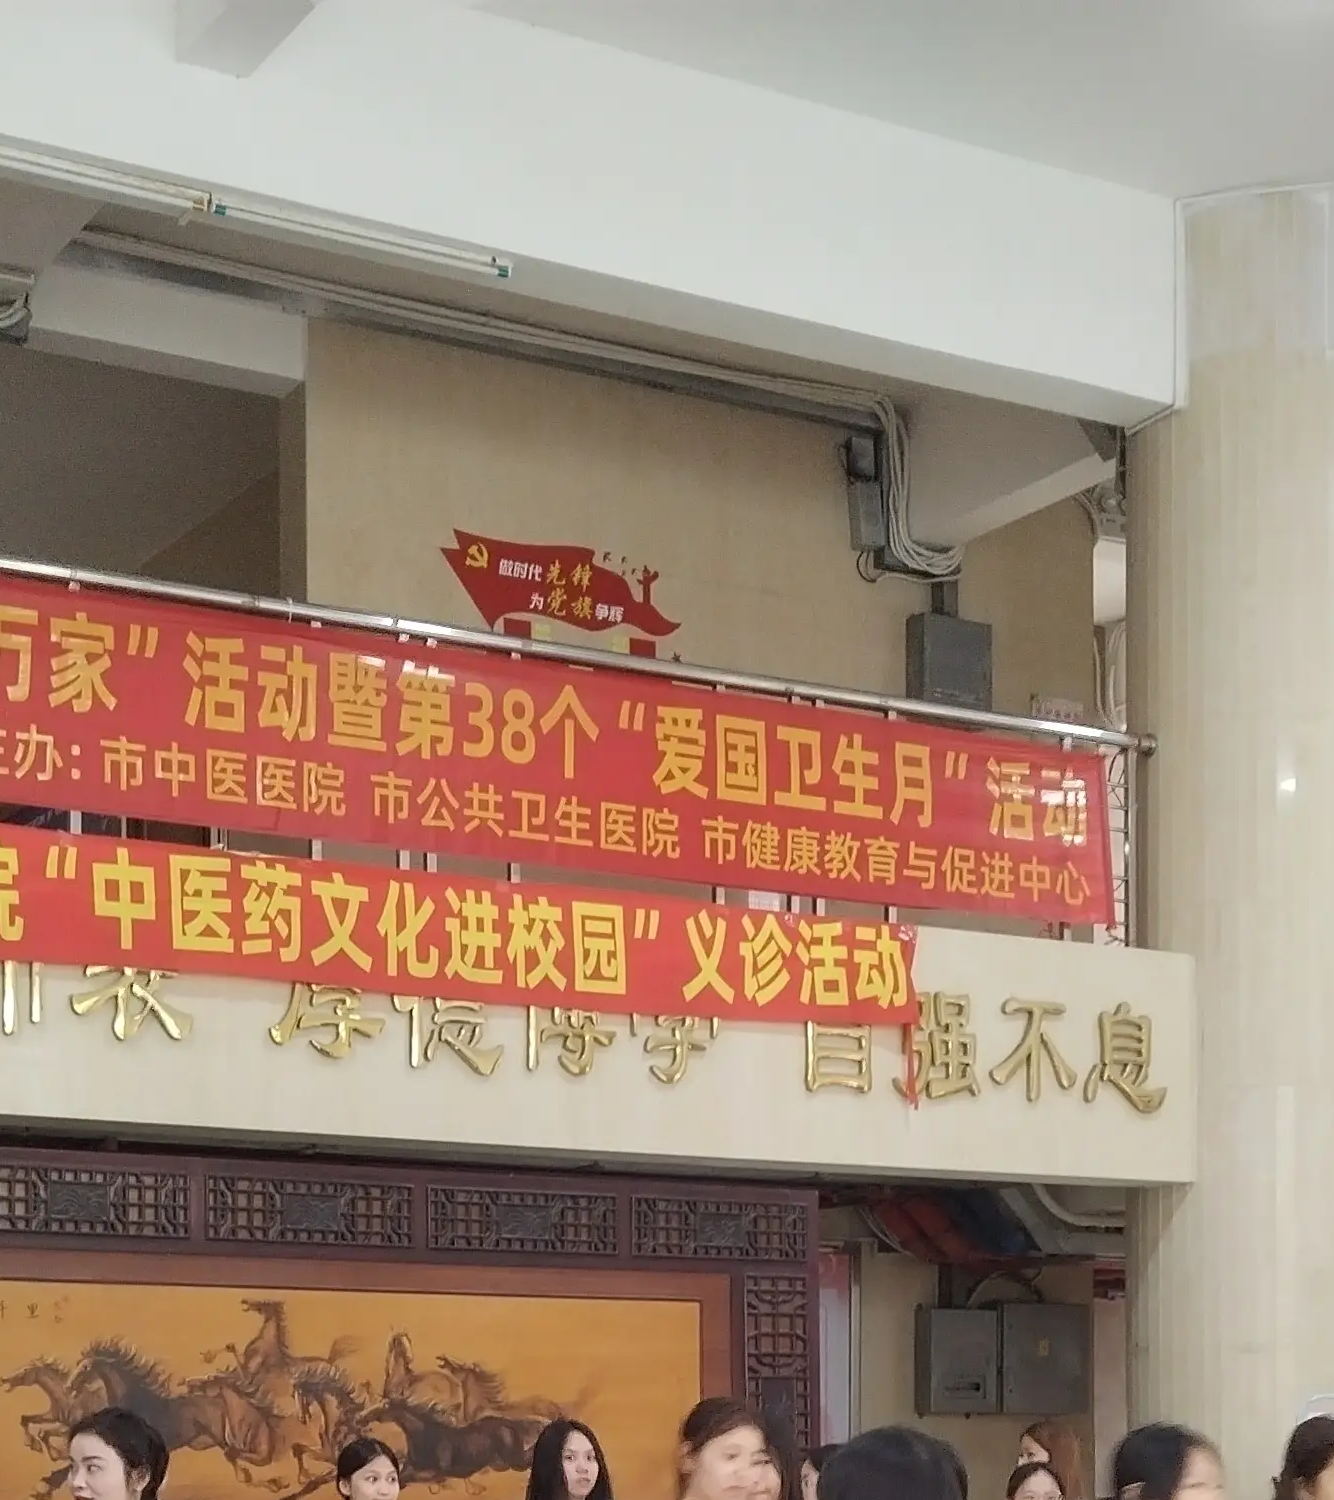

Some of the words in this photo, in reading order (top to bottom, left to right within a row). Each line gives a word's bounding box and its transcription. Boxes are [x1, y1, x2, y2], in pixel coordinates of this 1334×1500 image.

[498, 557, 593, 593] 做时代先锋
[528, 587, 624, 624] 为党旗争辉
[371, 773, 681, 860] 市公共卫生医院
[701, 814, 1091, 907] 市健康教育与促进中心
[804, 990, 1168, 1114] 自强不息
